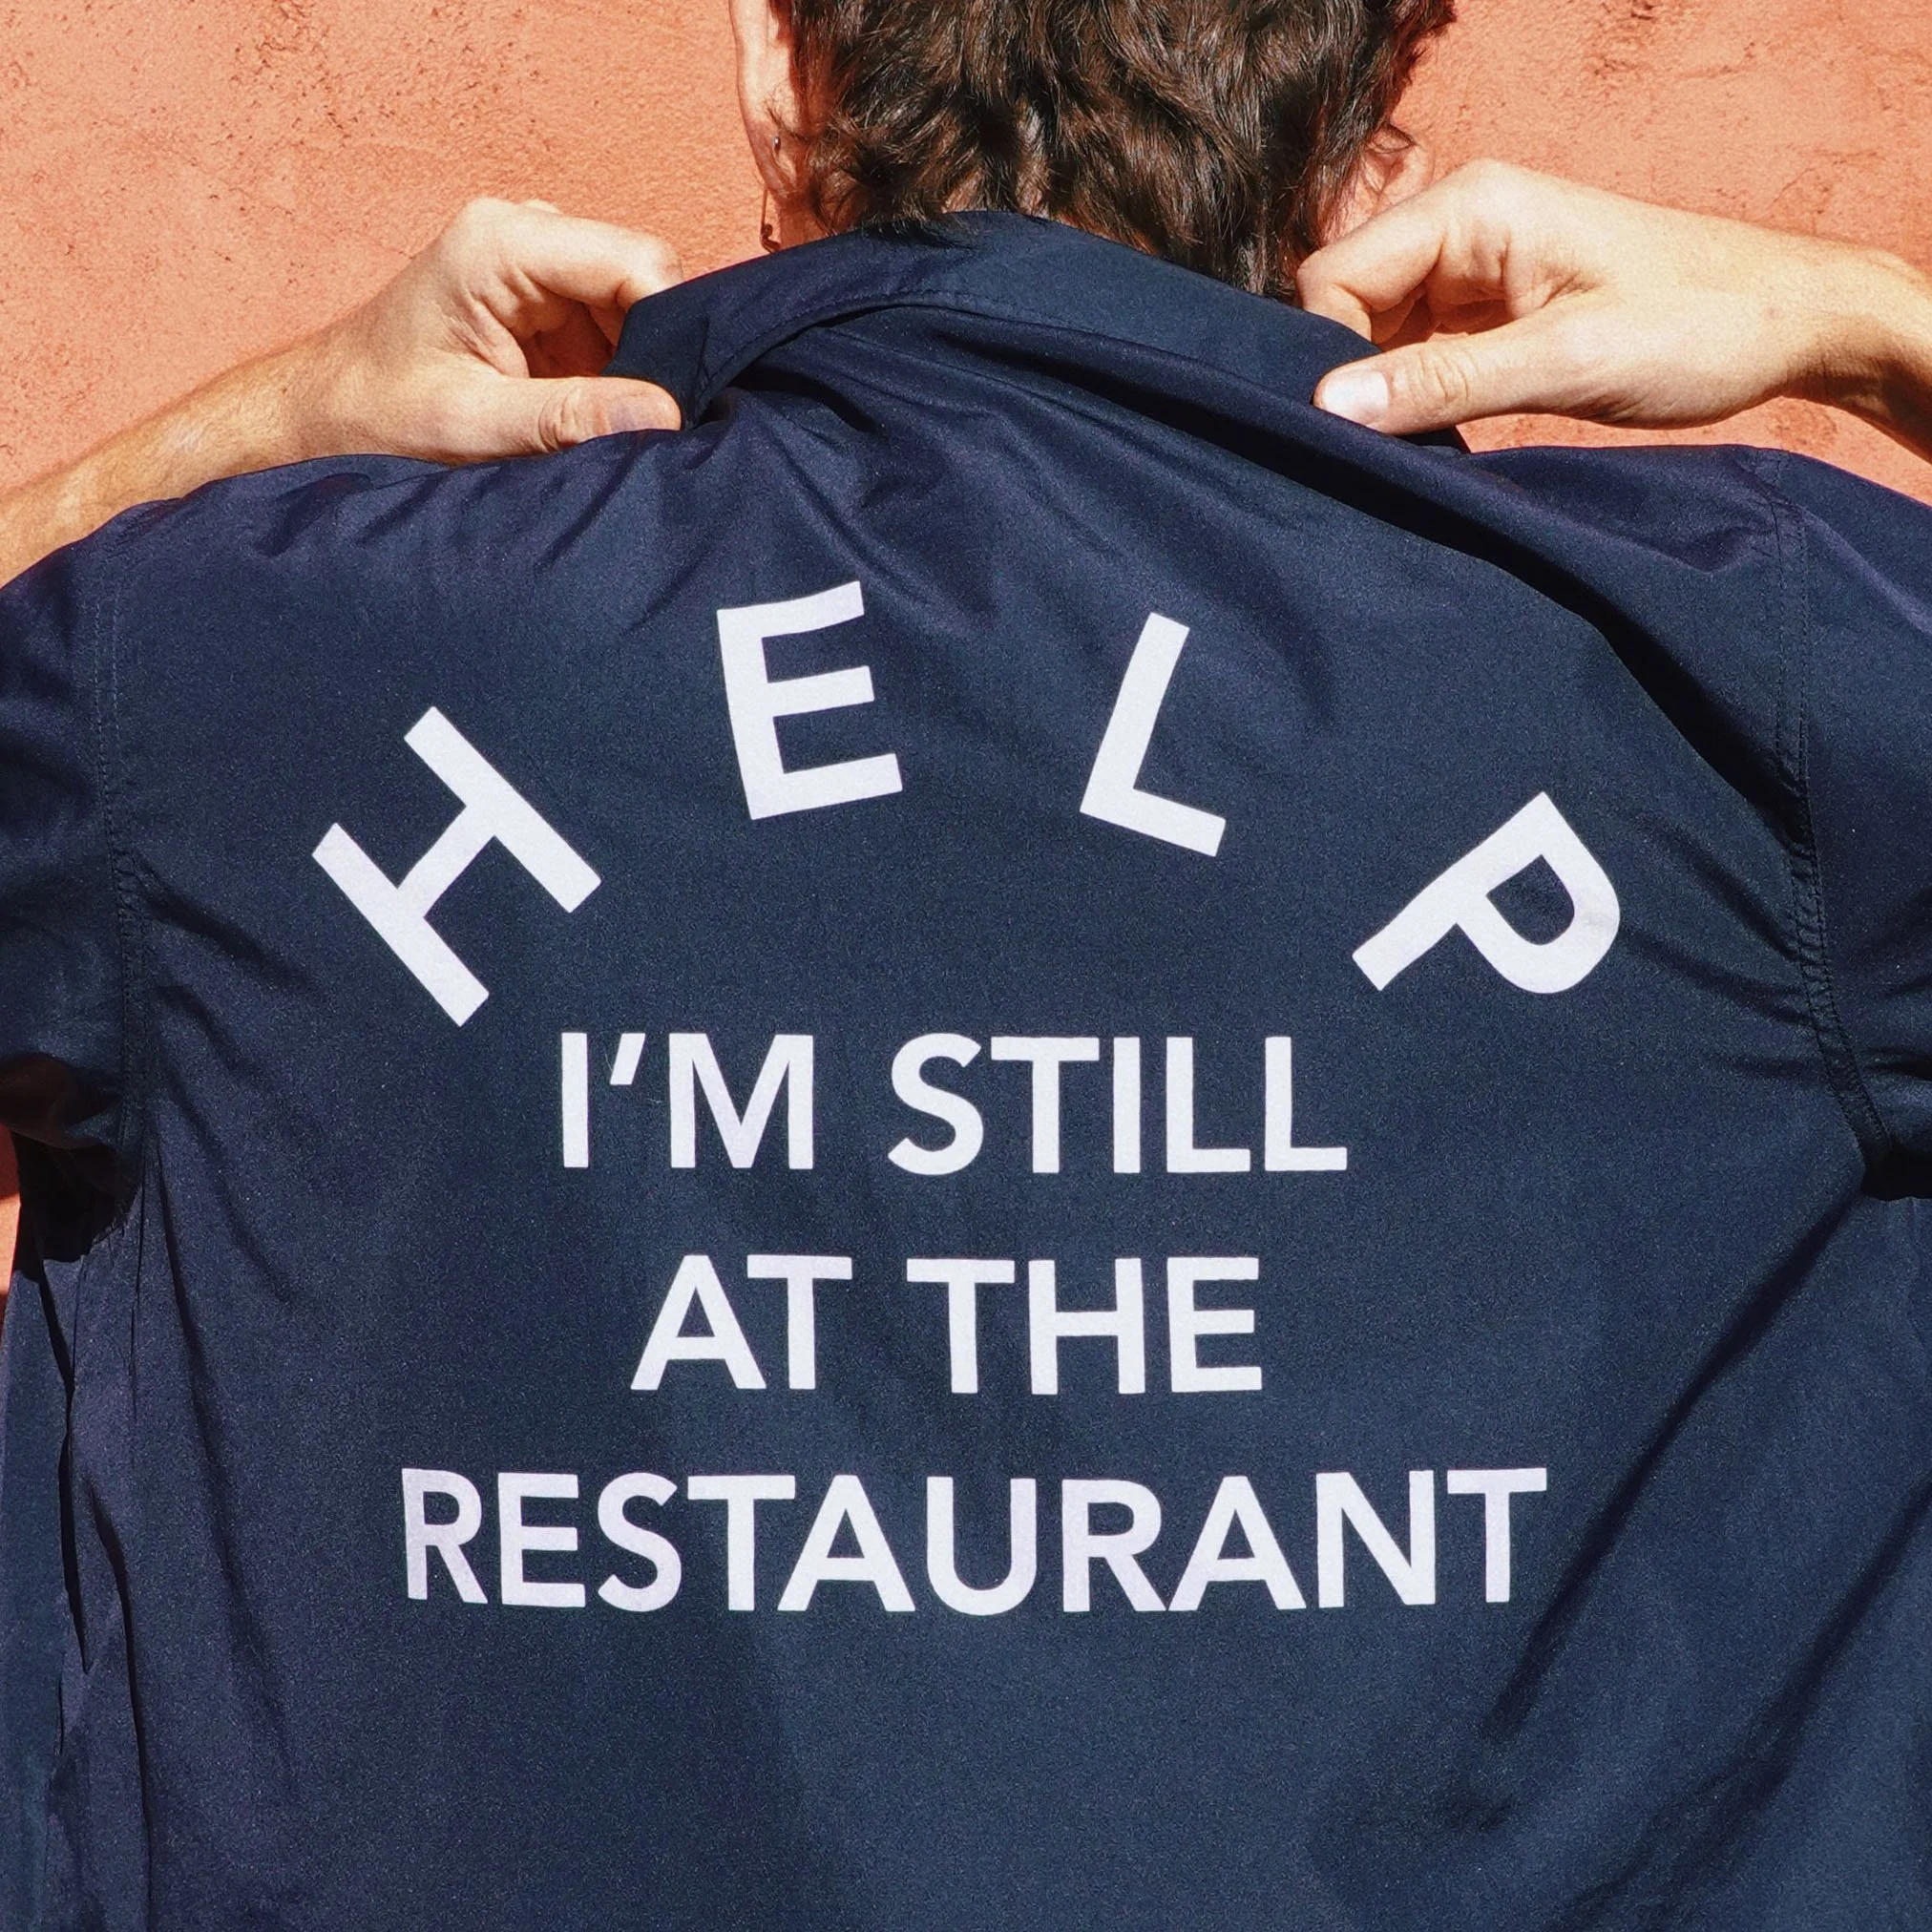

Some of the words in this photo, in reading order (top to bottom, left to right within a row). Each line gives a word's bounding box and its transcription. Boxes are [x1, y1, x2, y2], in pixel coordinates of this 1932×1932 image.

[312, 580, 1622, 1027] HELP
[560, 1032, 815, 1170] I’M
[888, 1033, 1349, 1176] STILL
[630, 1254, 852, 1391] AT
[906, 1256, 1264, 1396] THE
[401, 1467, 1547, 1616] RESTAURANT
